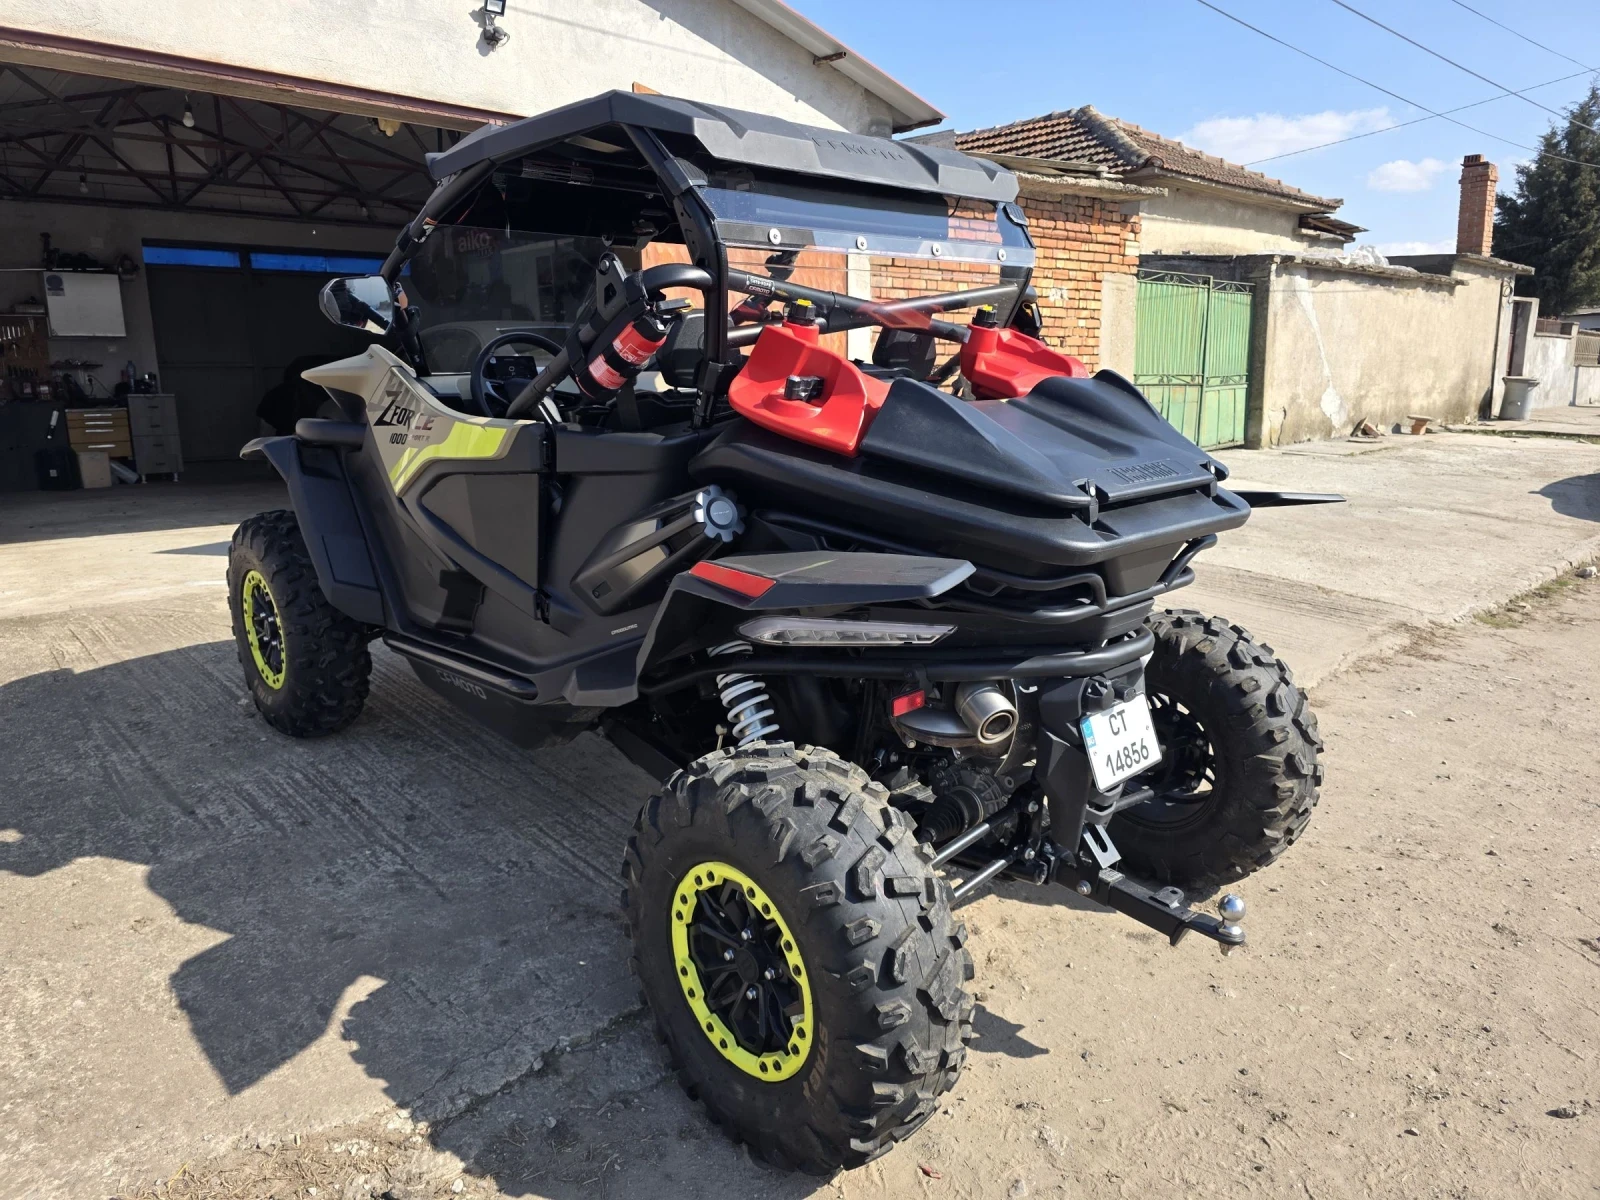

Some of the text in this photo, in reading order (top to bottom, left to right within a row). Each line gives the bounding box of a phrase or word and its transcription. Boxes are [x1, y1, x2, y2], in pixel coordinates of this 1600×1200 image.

[458, 229, 491, 253] aiko
[389, 433, 409, 445] 1000
[435, 669, 487, 700] CFMOTO
[1108, 709, 1127, 736] CT
[1106, 738, 1149, 776] 14856
